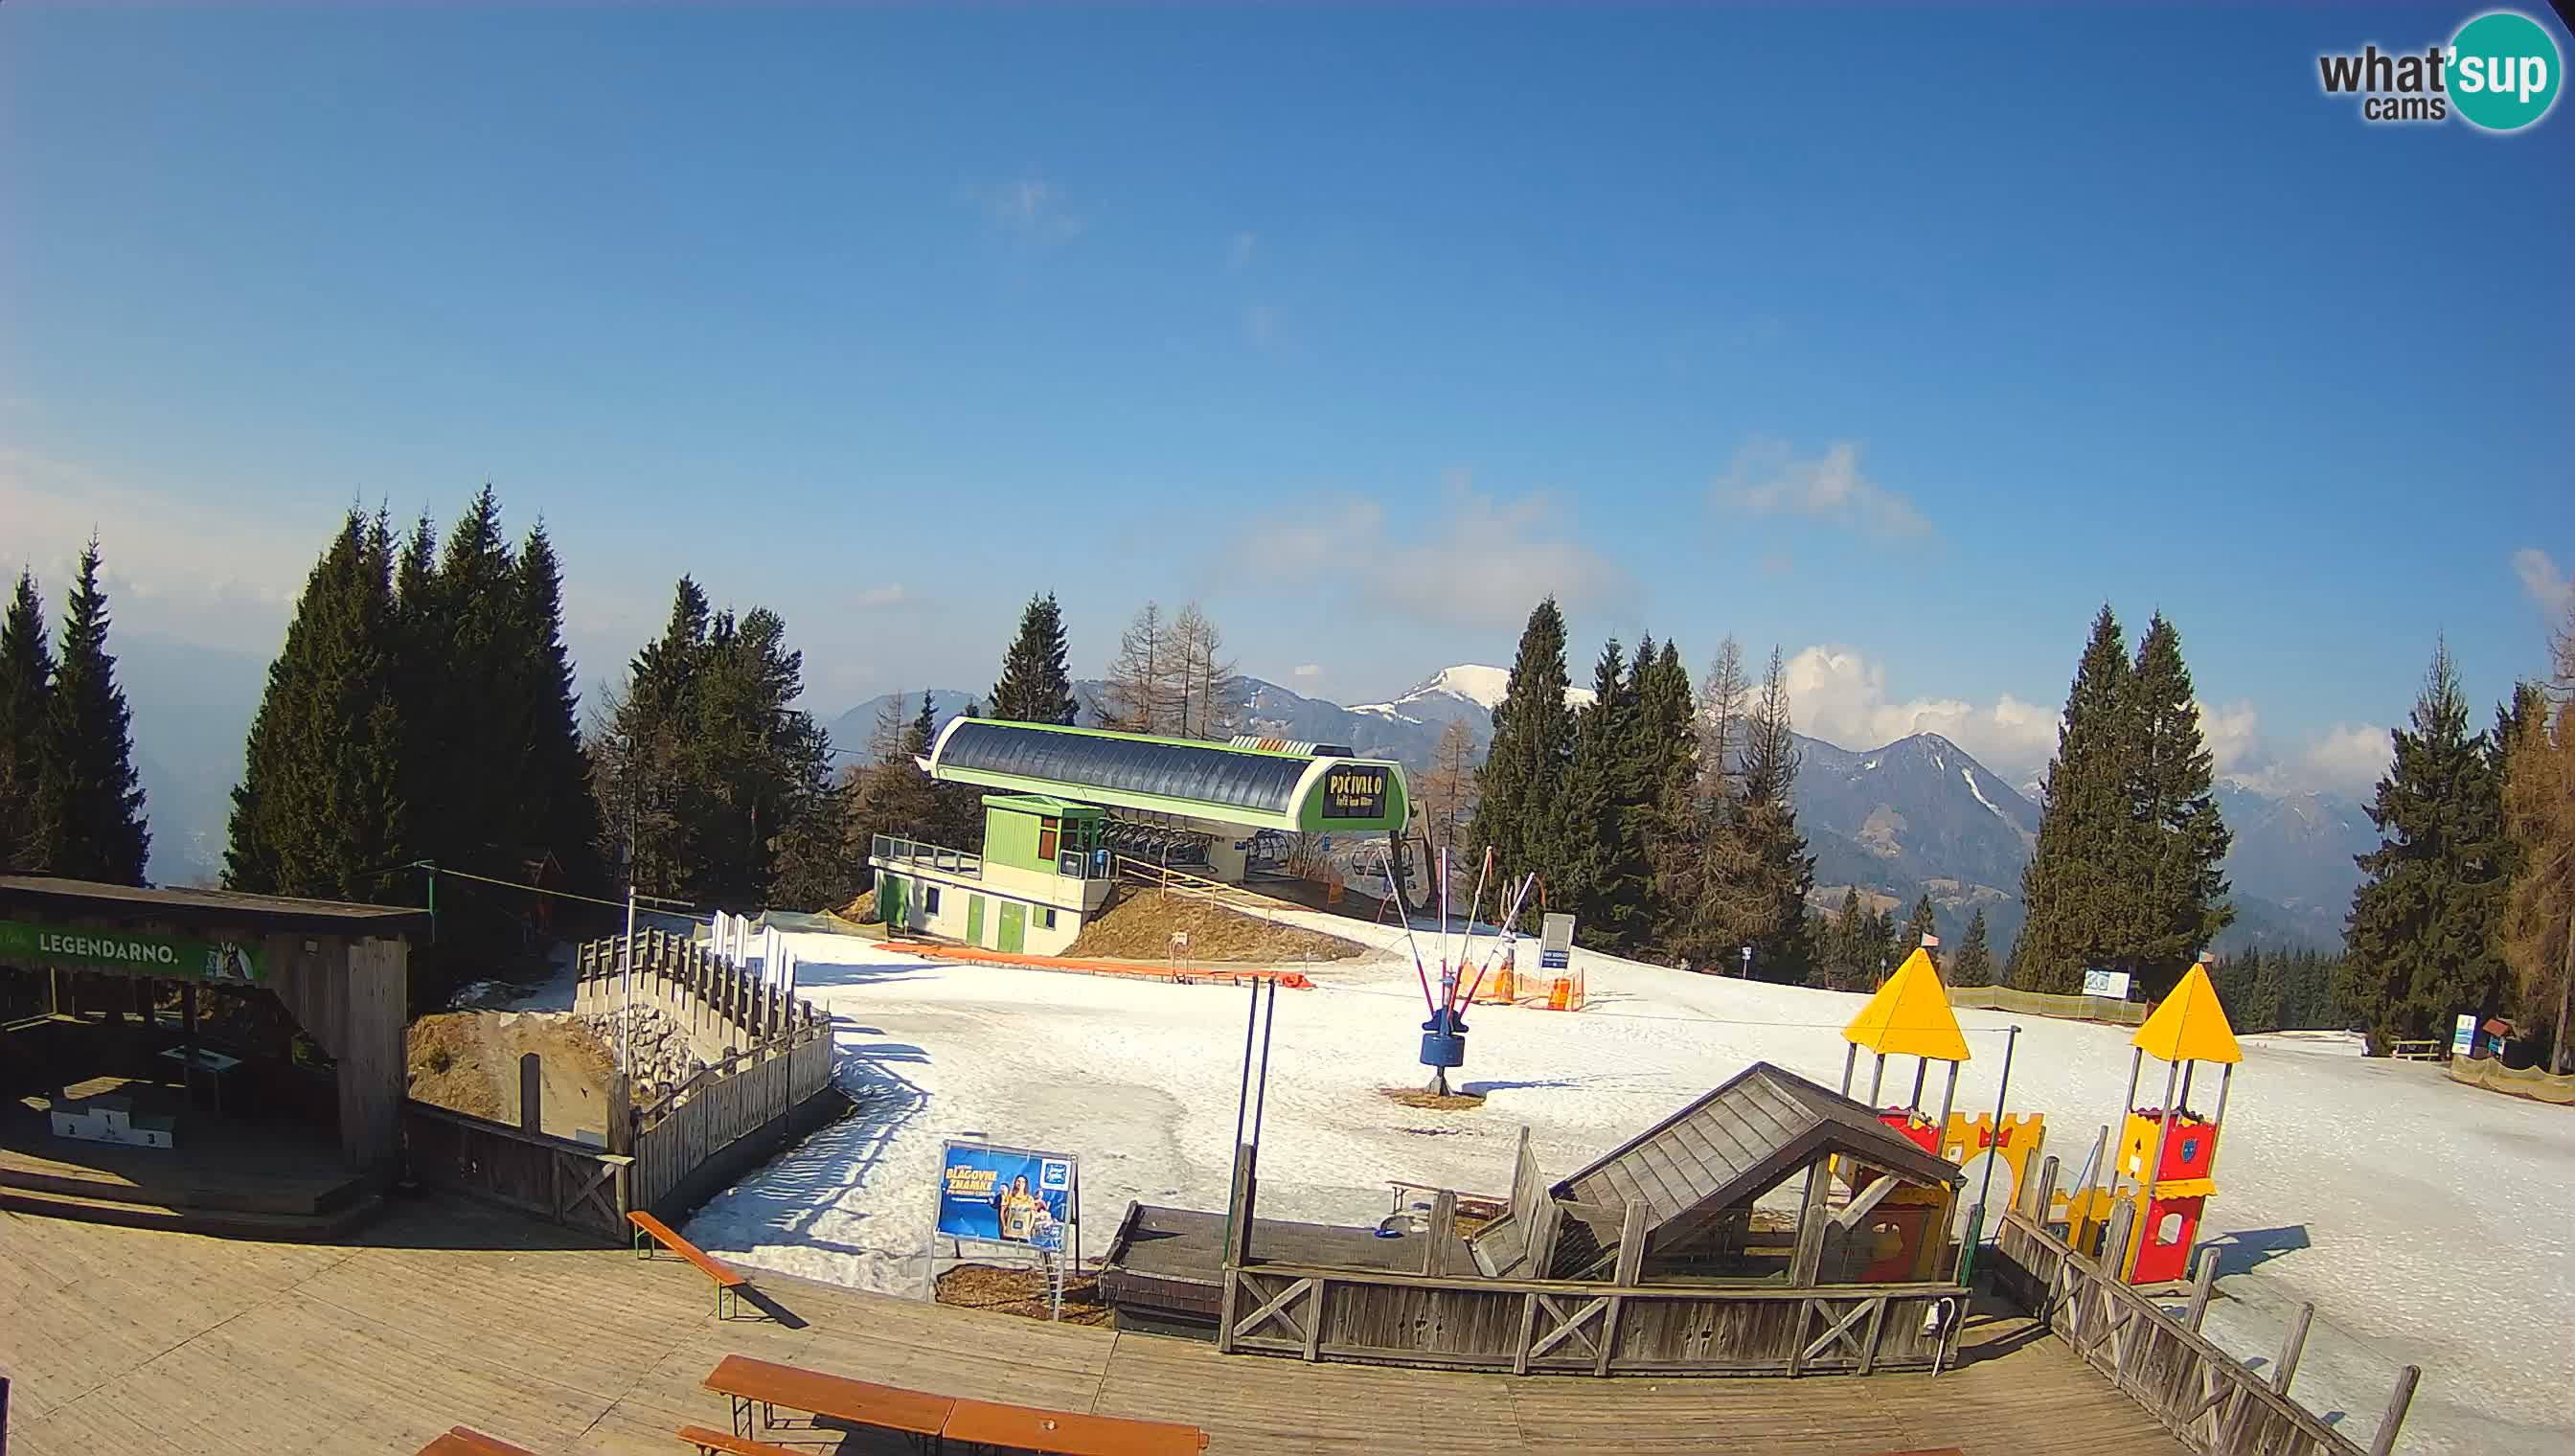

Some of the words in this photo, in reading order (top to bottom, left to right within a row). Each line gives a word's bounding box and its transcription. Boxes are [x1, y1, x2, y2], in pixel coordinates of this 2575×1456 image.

[39, 933, 180, 965] LEGENDARNO.
[148, 1133, 155, 1145] 3
[948, 1179, 993, 1192] ZNAMKE
